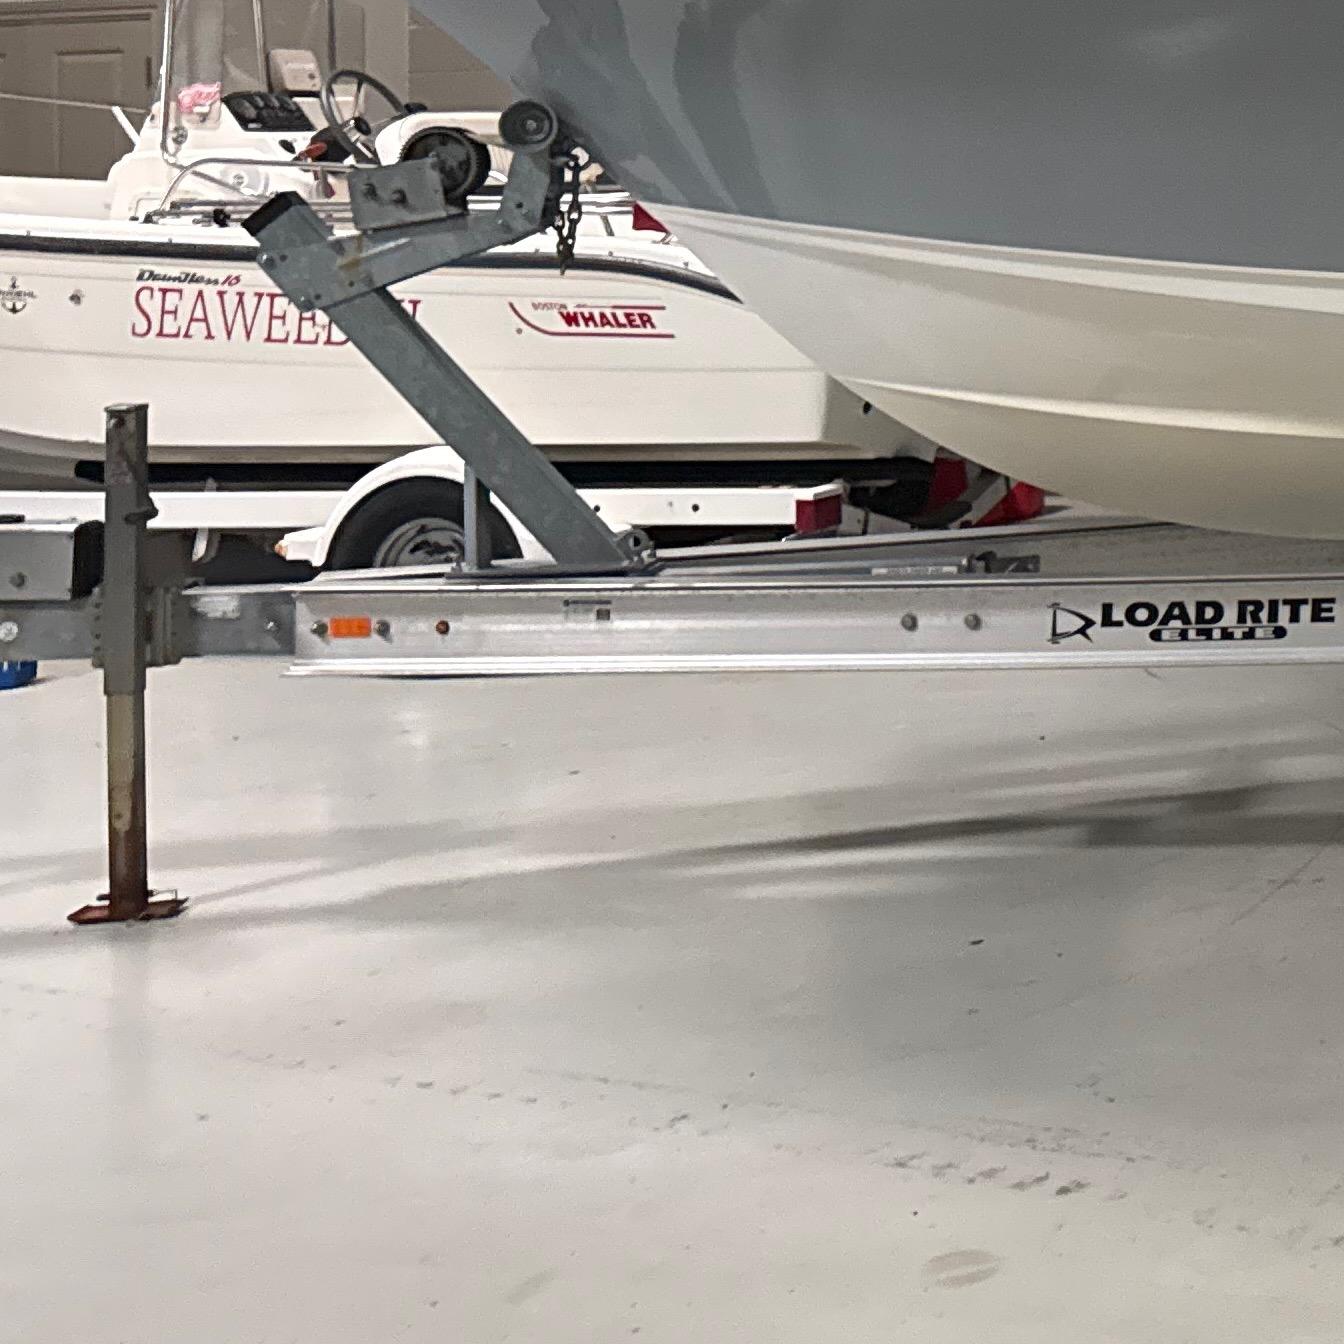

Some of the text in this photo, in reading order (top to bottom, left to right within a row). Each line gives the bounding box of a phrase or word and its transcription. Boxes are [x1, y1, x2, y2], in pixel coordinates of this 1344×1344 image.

[558, 310, 656, 330] WHALER
[1100, 597, 1337, 627] LOAD RITE
[1160, 626, 1276, 640] ELITE
